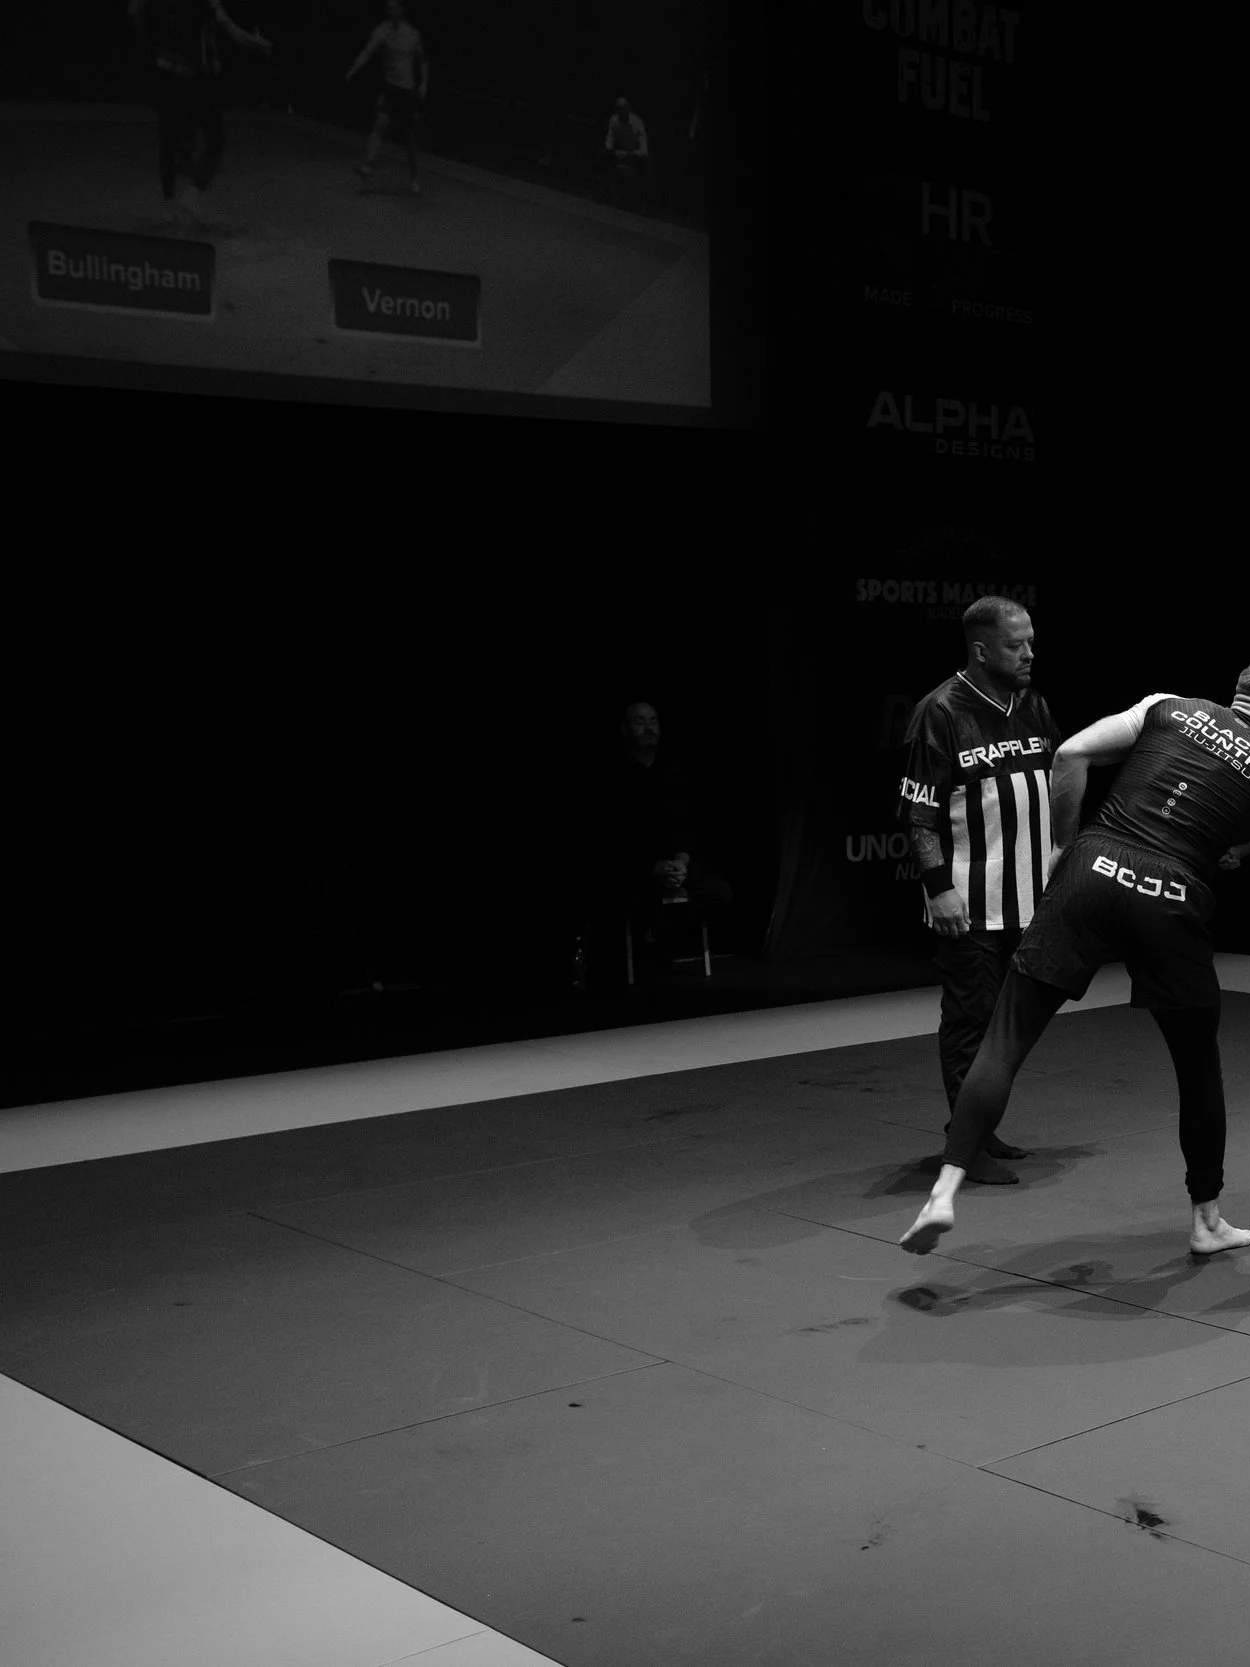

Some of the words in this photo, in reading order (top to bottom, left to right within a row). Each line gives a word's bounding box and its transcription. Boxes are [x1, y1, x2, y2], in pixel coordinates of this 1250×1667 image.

[861, 0, 1020, 65] COMBAT
[897, 46, 991, 122] FUEL
[921, 181, 994, 246] HR
[46, 249, 201, 291] Bullingham
[362, 286, 451, 320] Vernon
[863, 284, 913, 307] MADE
[952, 298, 1033, 325] PROGRESS
[865, 390, 1035, 443] ALPHA
[935, 437, 1036, 462] DESIGNS
[855, 577, 938, 605] SPORTS
[958, 736, 1052, 768] GRAPPLEN
[846, 832, 911, 863] UNO
